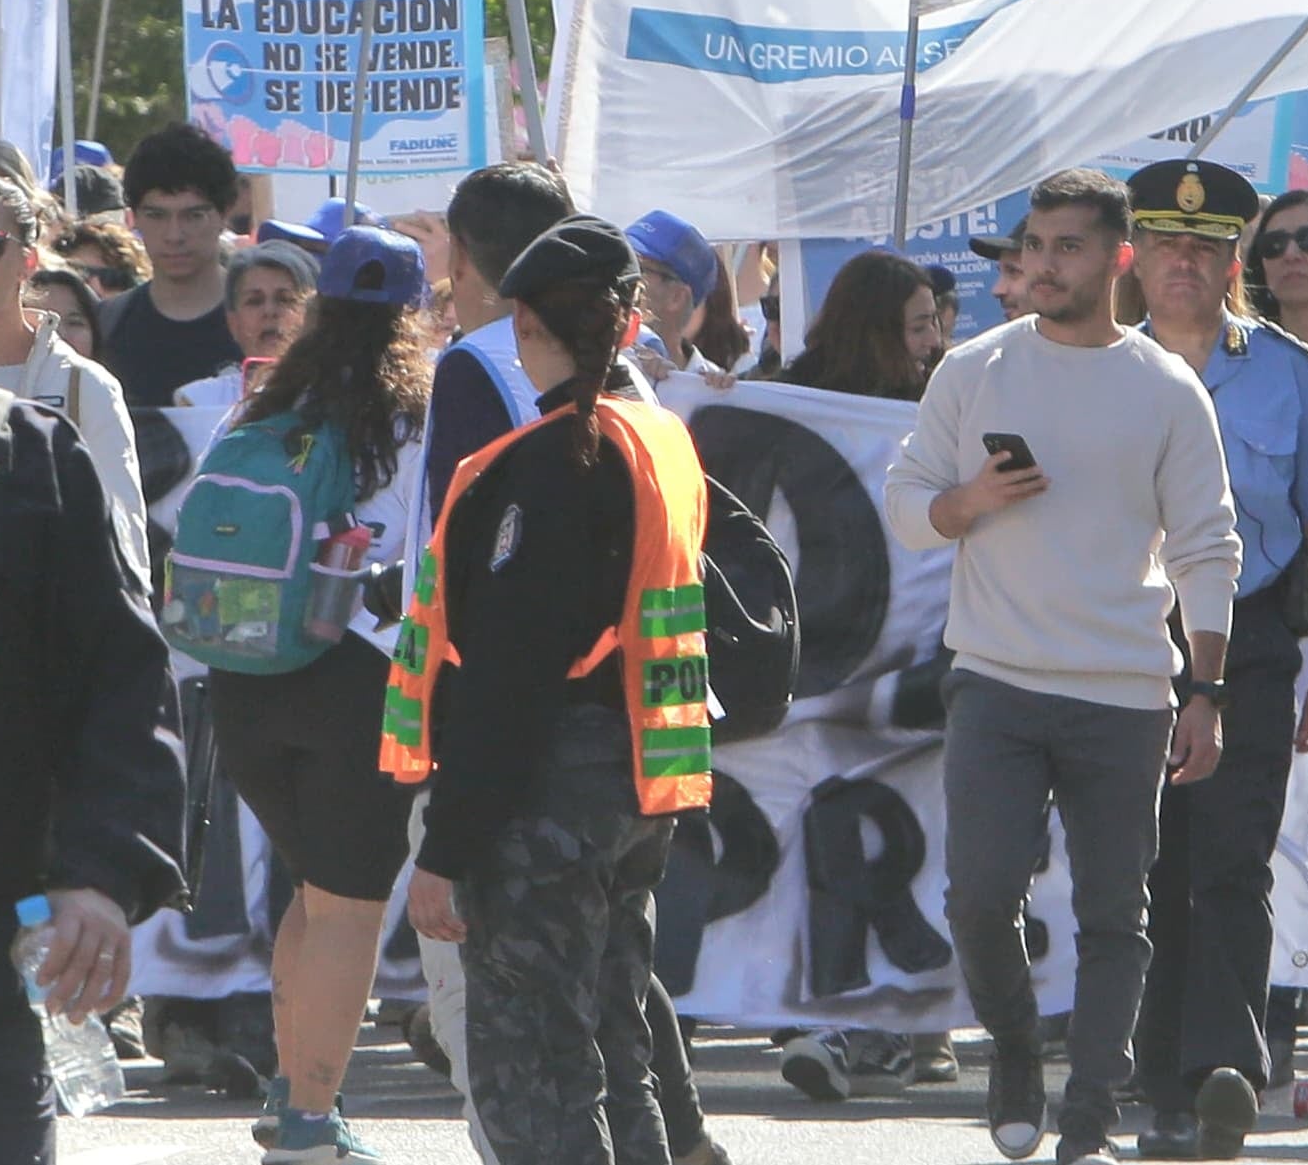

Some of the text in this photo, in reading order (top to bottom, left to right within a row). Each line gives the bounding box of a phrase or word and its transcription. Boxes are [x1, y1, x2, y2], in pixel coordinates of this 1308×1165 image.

[262, 41, 302, 72] NO
[315, 42, 349, 72] SE
[704, 33, 746, 66] UN
[748, 44, 869, 72] GREMIO
[265, 79, 302, 112] SE
[389, 136, 458, 151] FADIUNC
